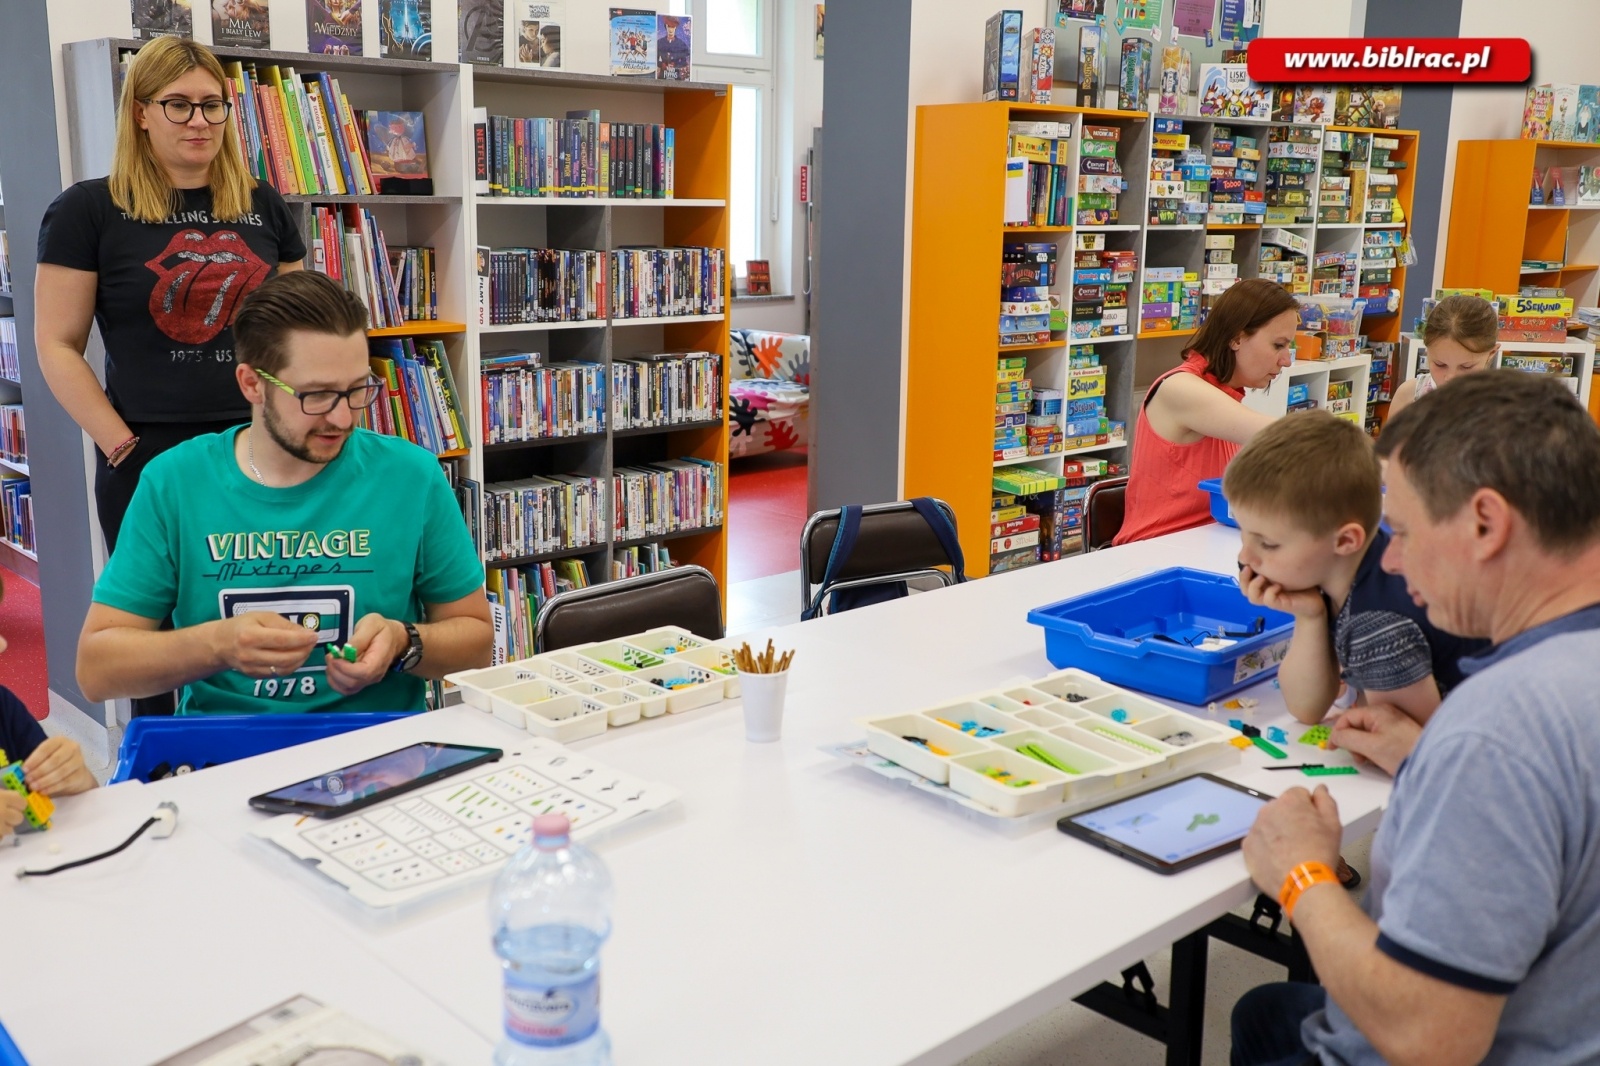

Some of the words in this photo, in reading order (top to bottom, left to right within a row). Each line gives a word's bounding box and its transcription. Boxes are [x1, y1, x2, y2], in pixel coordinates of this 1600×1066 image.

[229, 18, 252, 30] MIA
[1516, 300, 1526, 313] 5
[1070, 380, 1077, 395] 5
[206, 529, 371, 561] VINTAGE
[203, 561, 373, 581] Mixtapes
[254, 676, 316, 697] 1978
